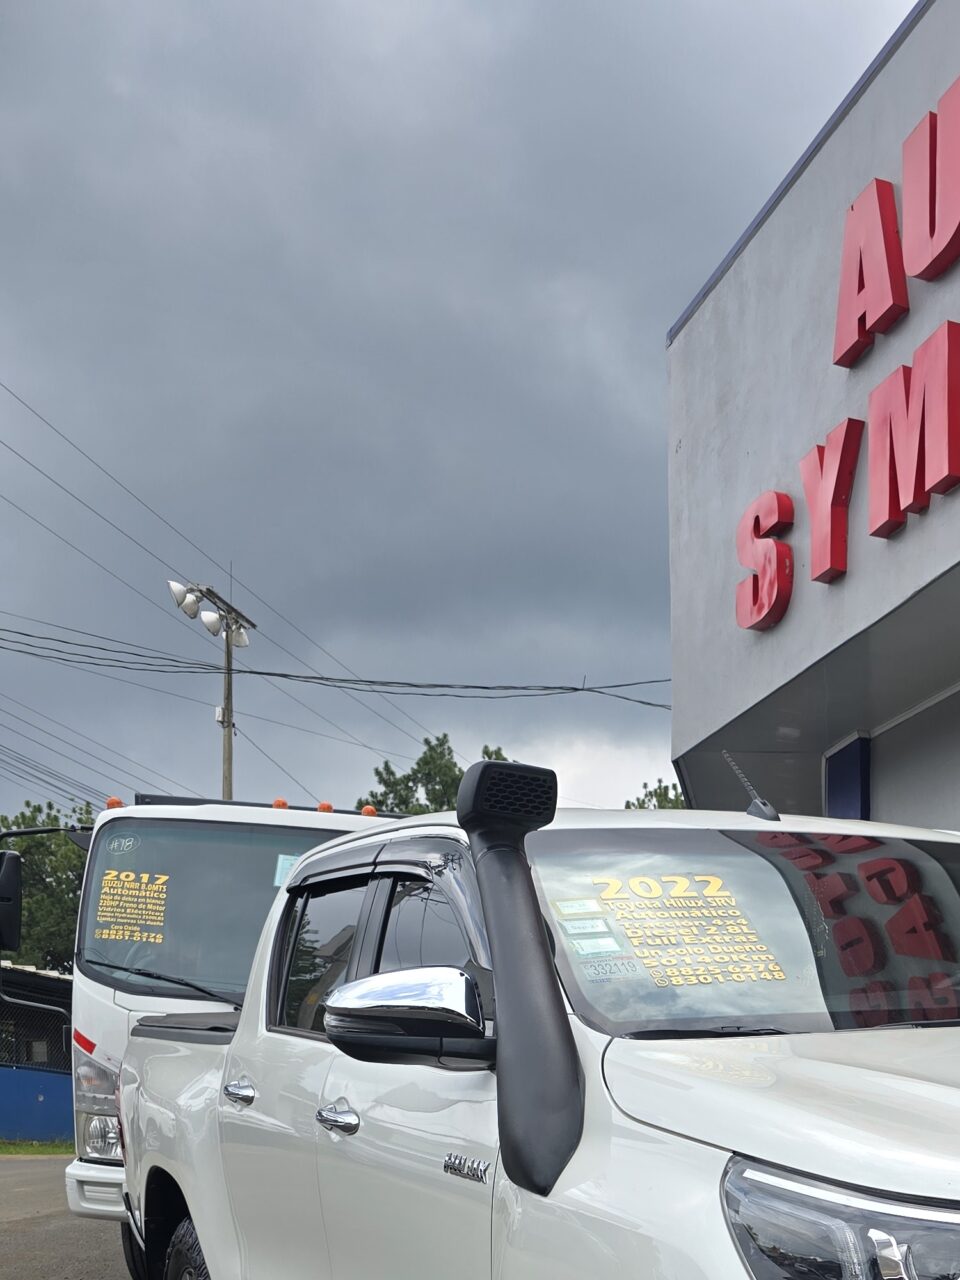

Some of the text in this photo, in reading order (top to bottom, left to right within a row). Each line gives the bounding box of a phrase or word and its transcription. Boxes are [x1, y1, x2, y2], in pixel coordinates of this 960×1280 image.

[103, 870, 170, 885] 2017
[101, 887, 167, 898] Automático
[592, 875, 731, 900] 2022
[603, 901, 662, 912] Toyota
[664, 898, 706, 909] Hilux
[709, 897, 736, 907] SRV
[616, 908, 741, 921] Automático
[711, 918, 748, 927] 4x4
[625, 925, 757, 938] Diesel 2.8L
[629, 934, 758, 947] Full Extras
[635, 948, 663, 959] Un
[667, 946, 705, 956] solo
[642, 953, 776, 968] 50140Km
[590, 960, 638, 977] 332119
[665, 963, 781, 977] 8825-6276
[670, 971, 787, 986] 8301-0148
